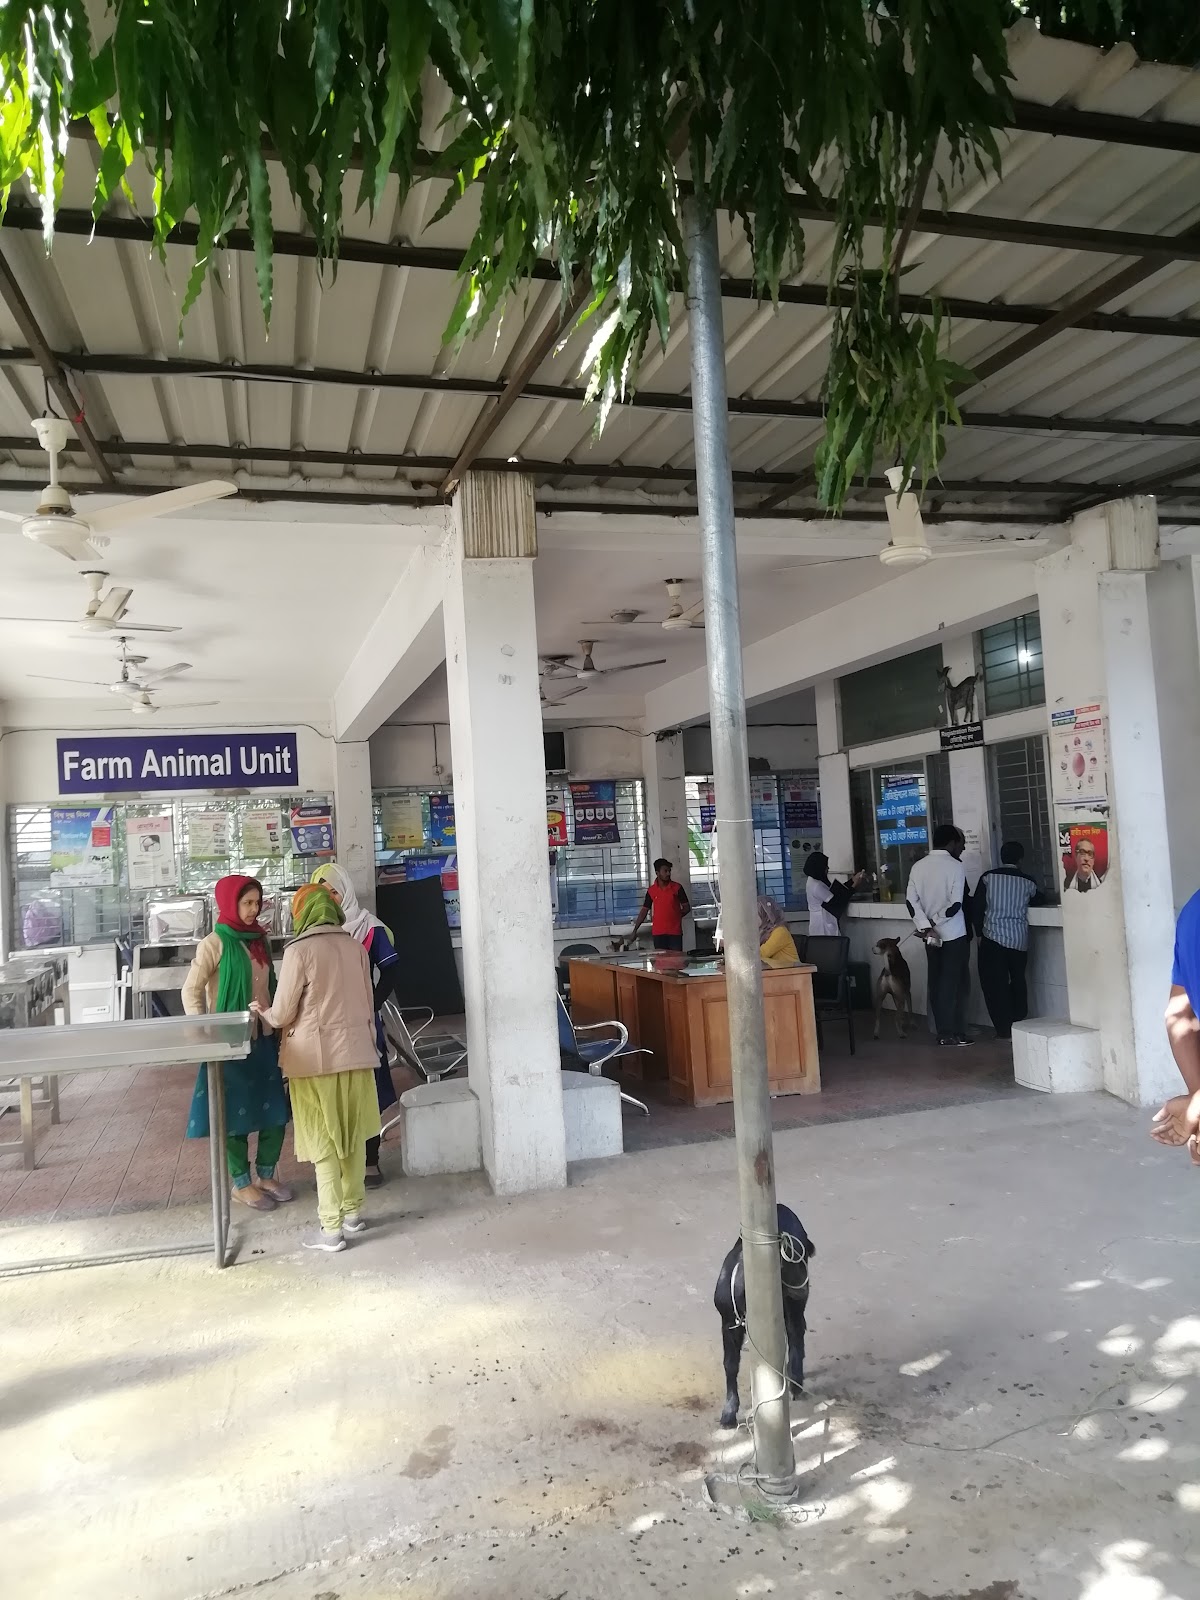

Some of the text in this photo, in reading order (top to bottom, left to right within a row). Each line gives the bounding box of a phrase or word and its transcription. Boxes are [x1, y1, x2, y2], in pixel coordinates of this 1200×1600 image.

[941, 725, 982, 738] Registration Room
[63, 746, 292, 781] Farm Animal Unit
[1059, 832, 1070, 845] ১৫
